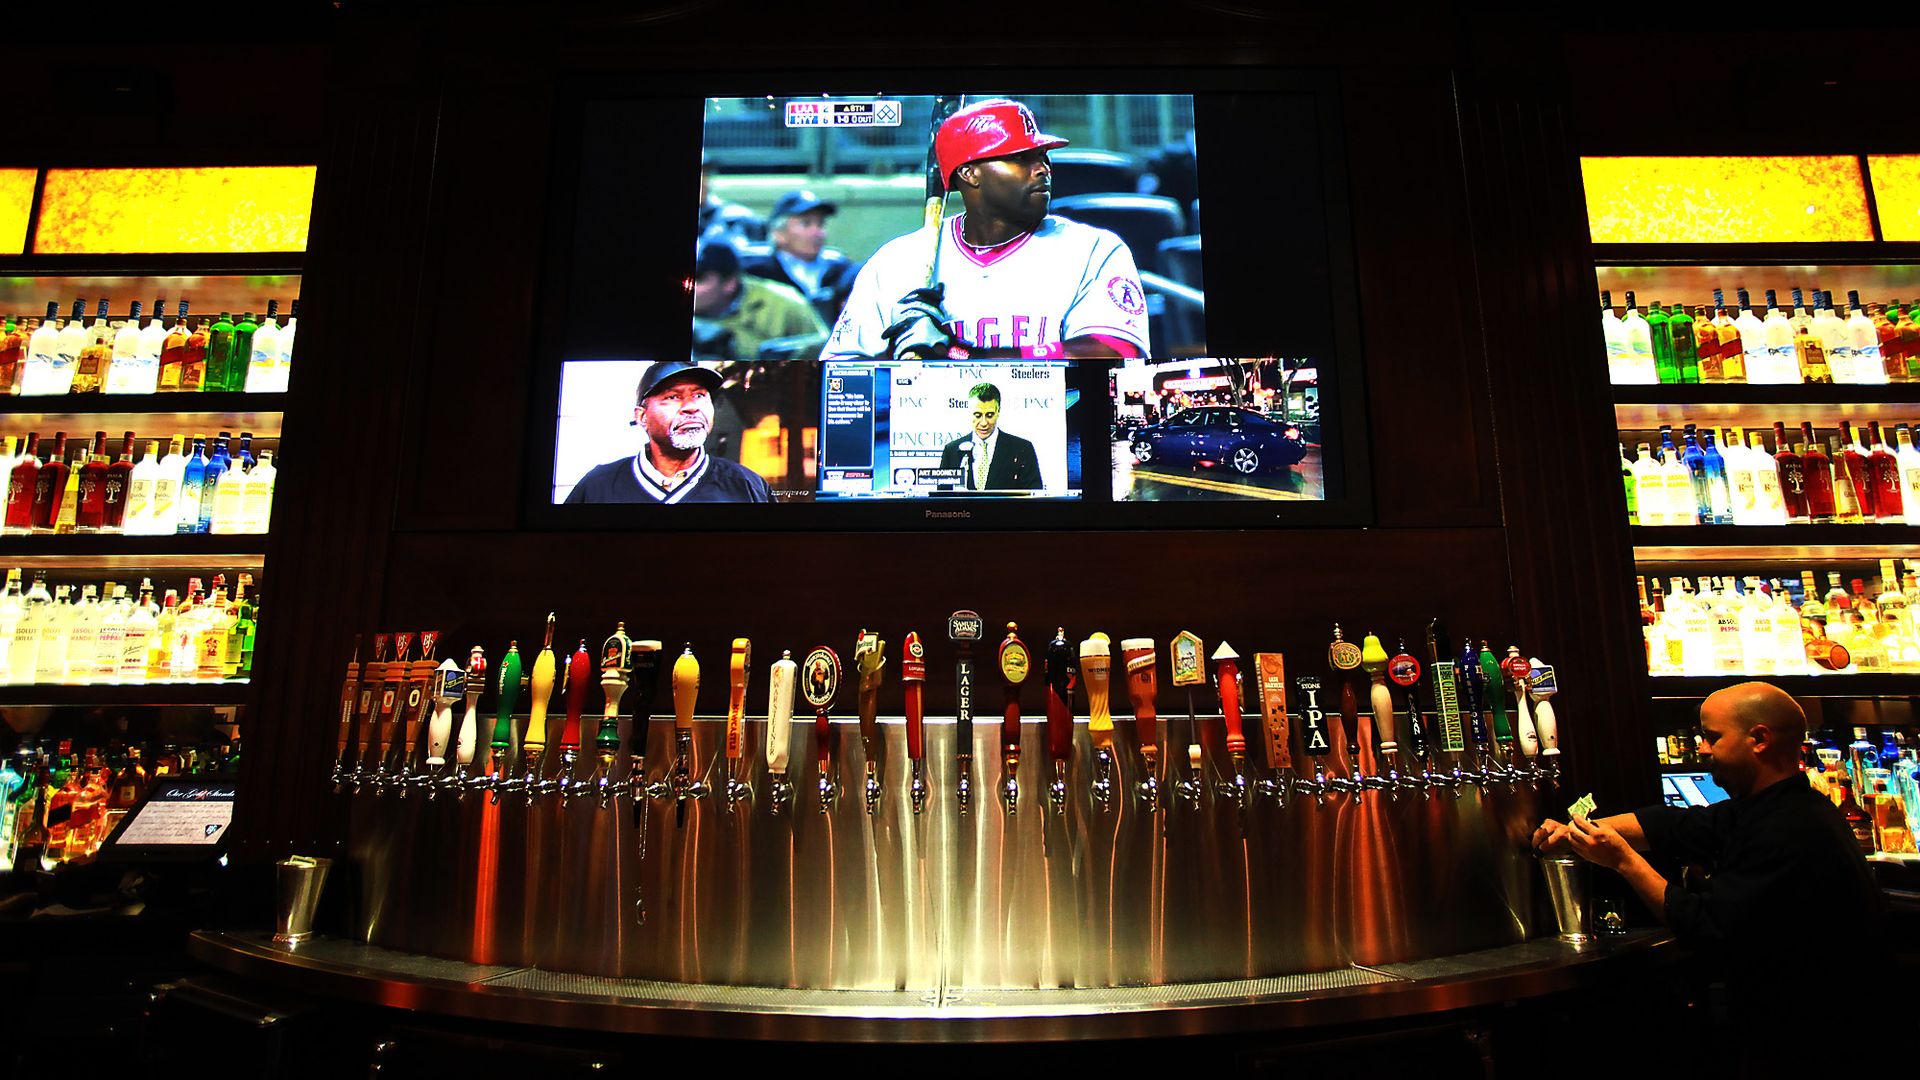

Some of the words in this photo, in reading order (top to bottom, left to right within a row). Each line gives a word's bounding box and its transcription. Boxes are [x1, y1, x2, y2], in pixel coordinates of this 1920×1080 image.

[959, 368, 987, 379] PNC
[1011, 368, 1050, 379] Steelers
[899, 396, 928, 408] PNC
[1024, 396, 1053, 409] PNC
[893, 431, 932, 446] PNC
[925, 509, 971, 518] Panasonic
[952, 620, 979, 628] SAMUEL
[954, 624, 977, 632] ADAMS
[960, 660, 971, 721] LAGER
[1441, 680, 1458, 712] CHARLIE
[1306, 689, 1329, 749] IPA
[730, 703, 739, 751] NEWCASTLE
[1446, 713, 1463, 742] PARKER
